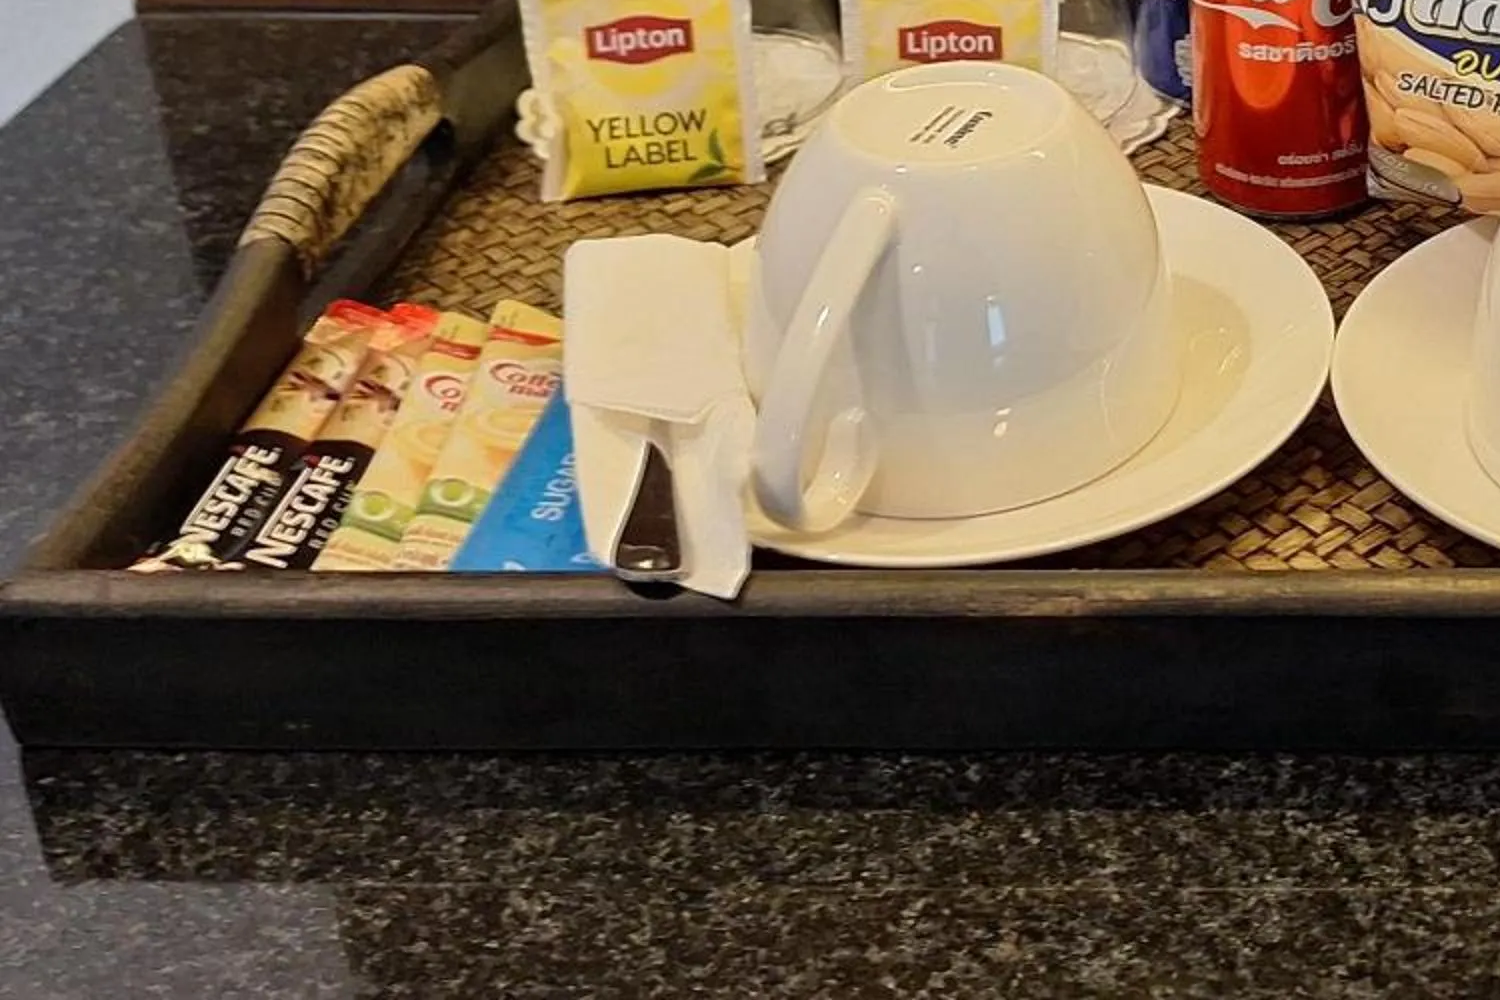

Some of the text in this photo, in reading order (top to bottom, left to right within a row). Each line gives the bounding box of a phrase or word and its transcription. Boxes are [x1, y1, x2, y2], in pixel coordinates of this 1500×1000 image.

[594, 26, 686, 57] Lipton
[906, 31, 995, 59] Lipton
[1398, 73, 1485, 109] SALTED
[586, 108, 707, 144] YELLOW
[605, 139, 697, 169] LABEL
